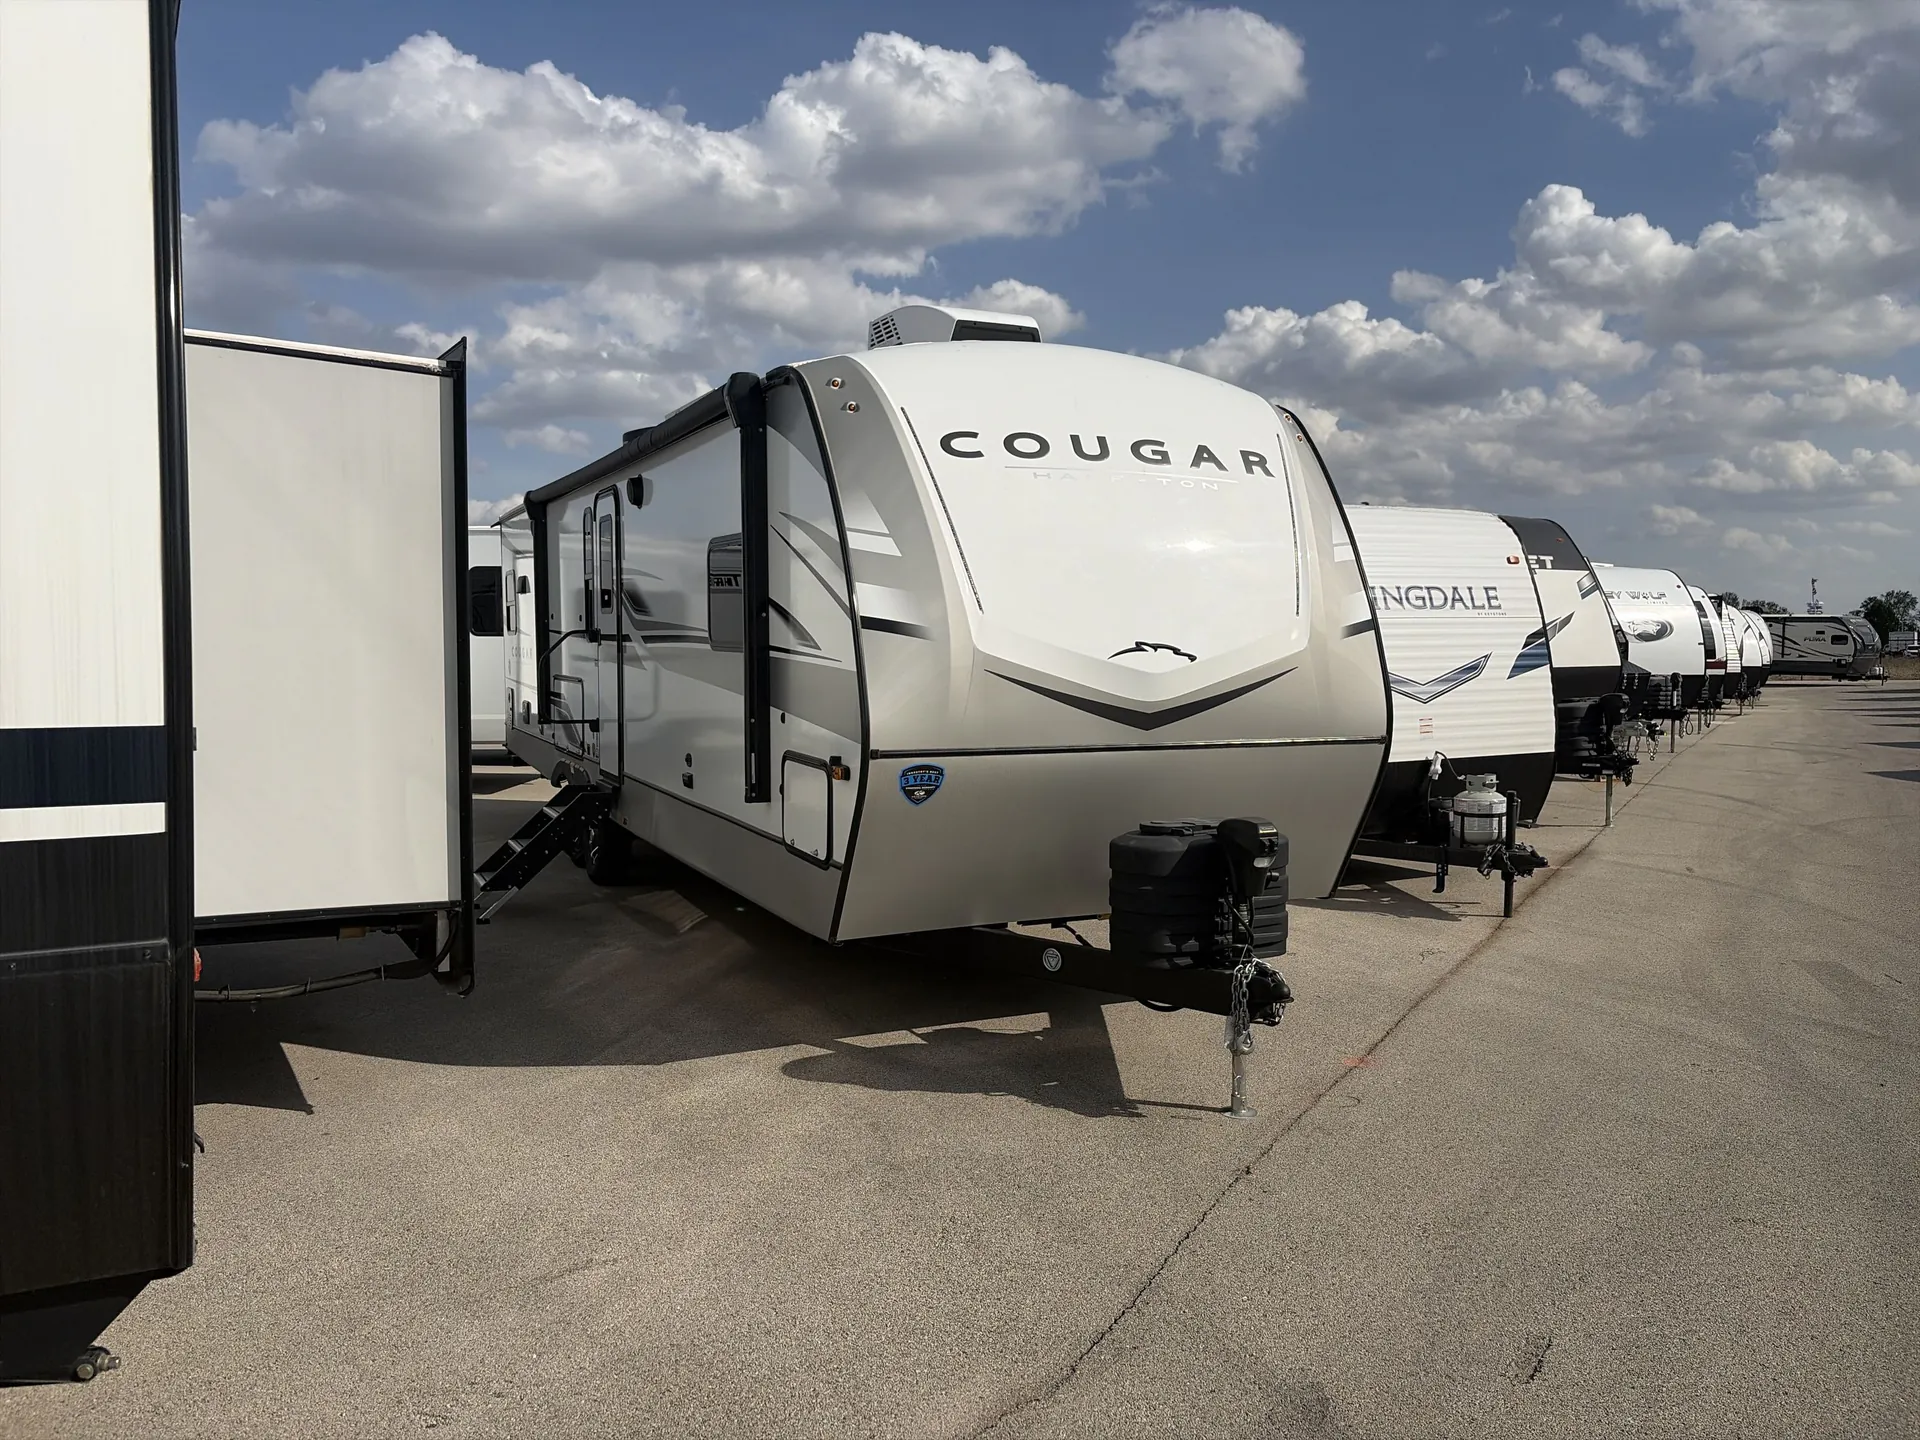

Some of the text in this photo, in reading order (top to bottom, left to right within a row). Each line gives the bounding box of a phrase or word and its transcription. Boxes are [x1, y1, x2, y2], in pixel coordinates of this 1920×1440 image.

[939, 431, 1276, 479] COUGAR
[1032, 472, 1219, 491] HAF-TON
[1527, 554, 1554, 569] ET
[1369, 585, 1503, 611] INGDALE
[1603, 590, 1622, 600] EY
[903, 774, 940, 785] 3 YEAR
